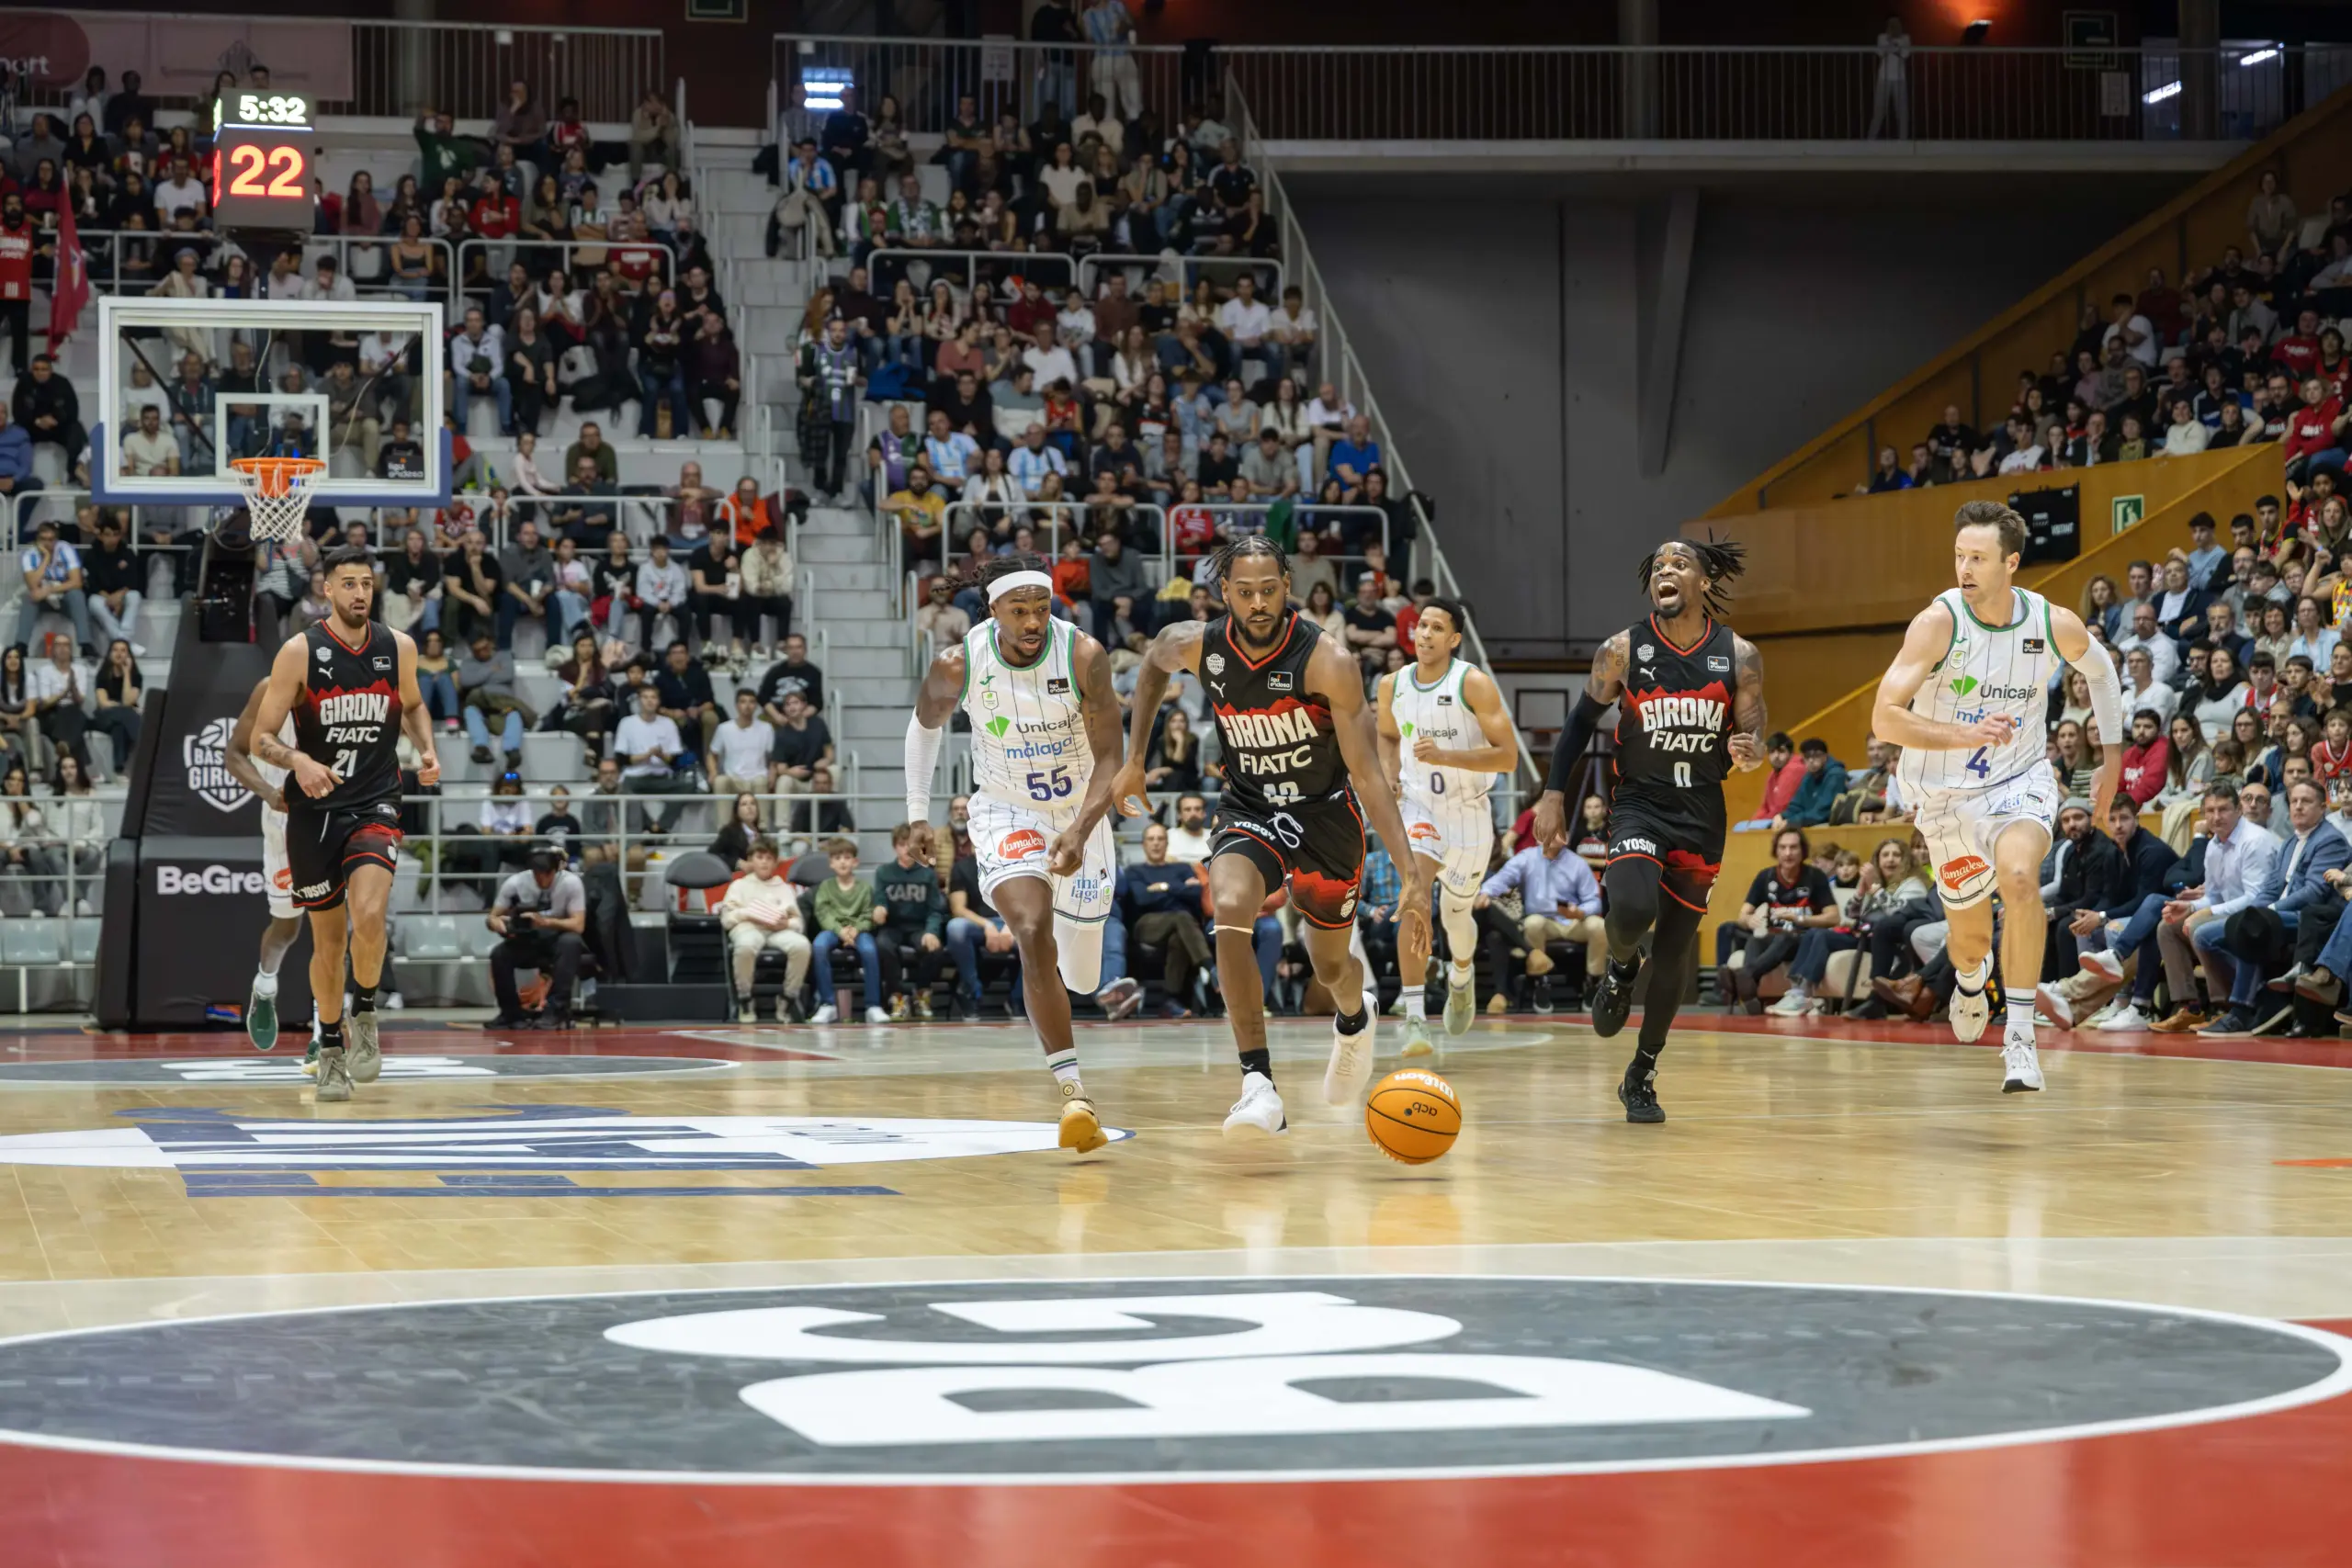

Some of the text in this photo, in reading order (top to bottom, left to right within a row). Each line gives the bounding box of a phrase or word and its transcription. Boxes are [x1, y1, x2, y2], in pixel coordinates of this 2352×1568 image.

[239, 95, 307, 124] 5:32
[230, 144, 304, 197] 22
[1980, 684, 2038, 703] Unicaja
[320, 693, 390, 726] GIRONA
[1015, 712, 1078, 734] Unicaja
[1639, 697, 1726, 733] GIRONA
[325, 726, 381, 744] FIATC
[1218, 706, 1319, 749] GIRONA
[1417, 728, 1458, 740] Unicaja
[1649, 729, 1718, 754] FIATC
[330, 749, 358, 778] 21
[1238, 744, 1313, 775] FIATC
[1965, 745, 1991, 779] 4
[1026, 764, 1073, 802] 55
[1430, 772, 1445, 795] 0
[1673, 761, 1692, 788] 0
[1233, 820, 1277, 841] YOSOY
[1622, 838, 1657, 856] YOSOY
[156, 864, 267, 895] BeGre
[304, 879, 333, 899] YOSOY
[1412, 1101, 1438, 1117] acb
